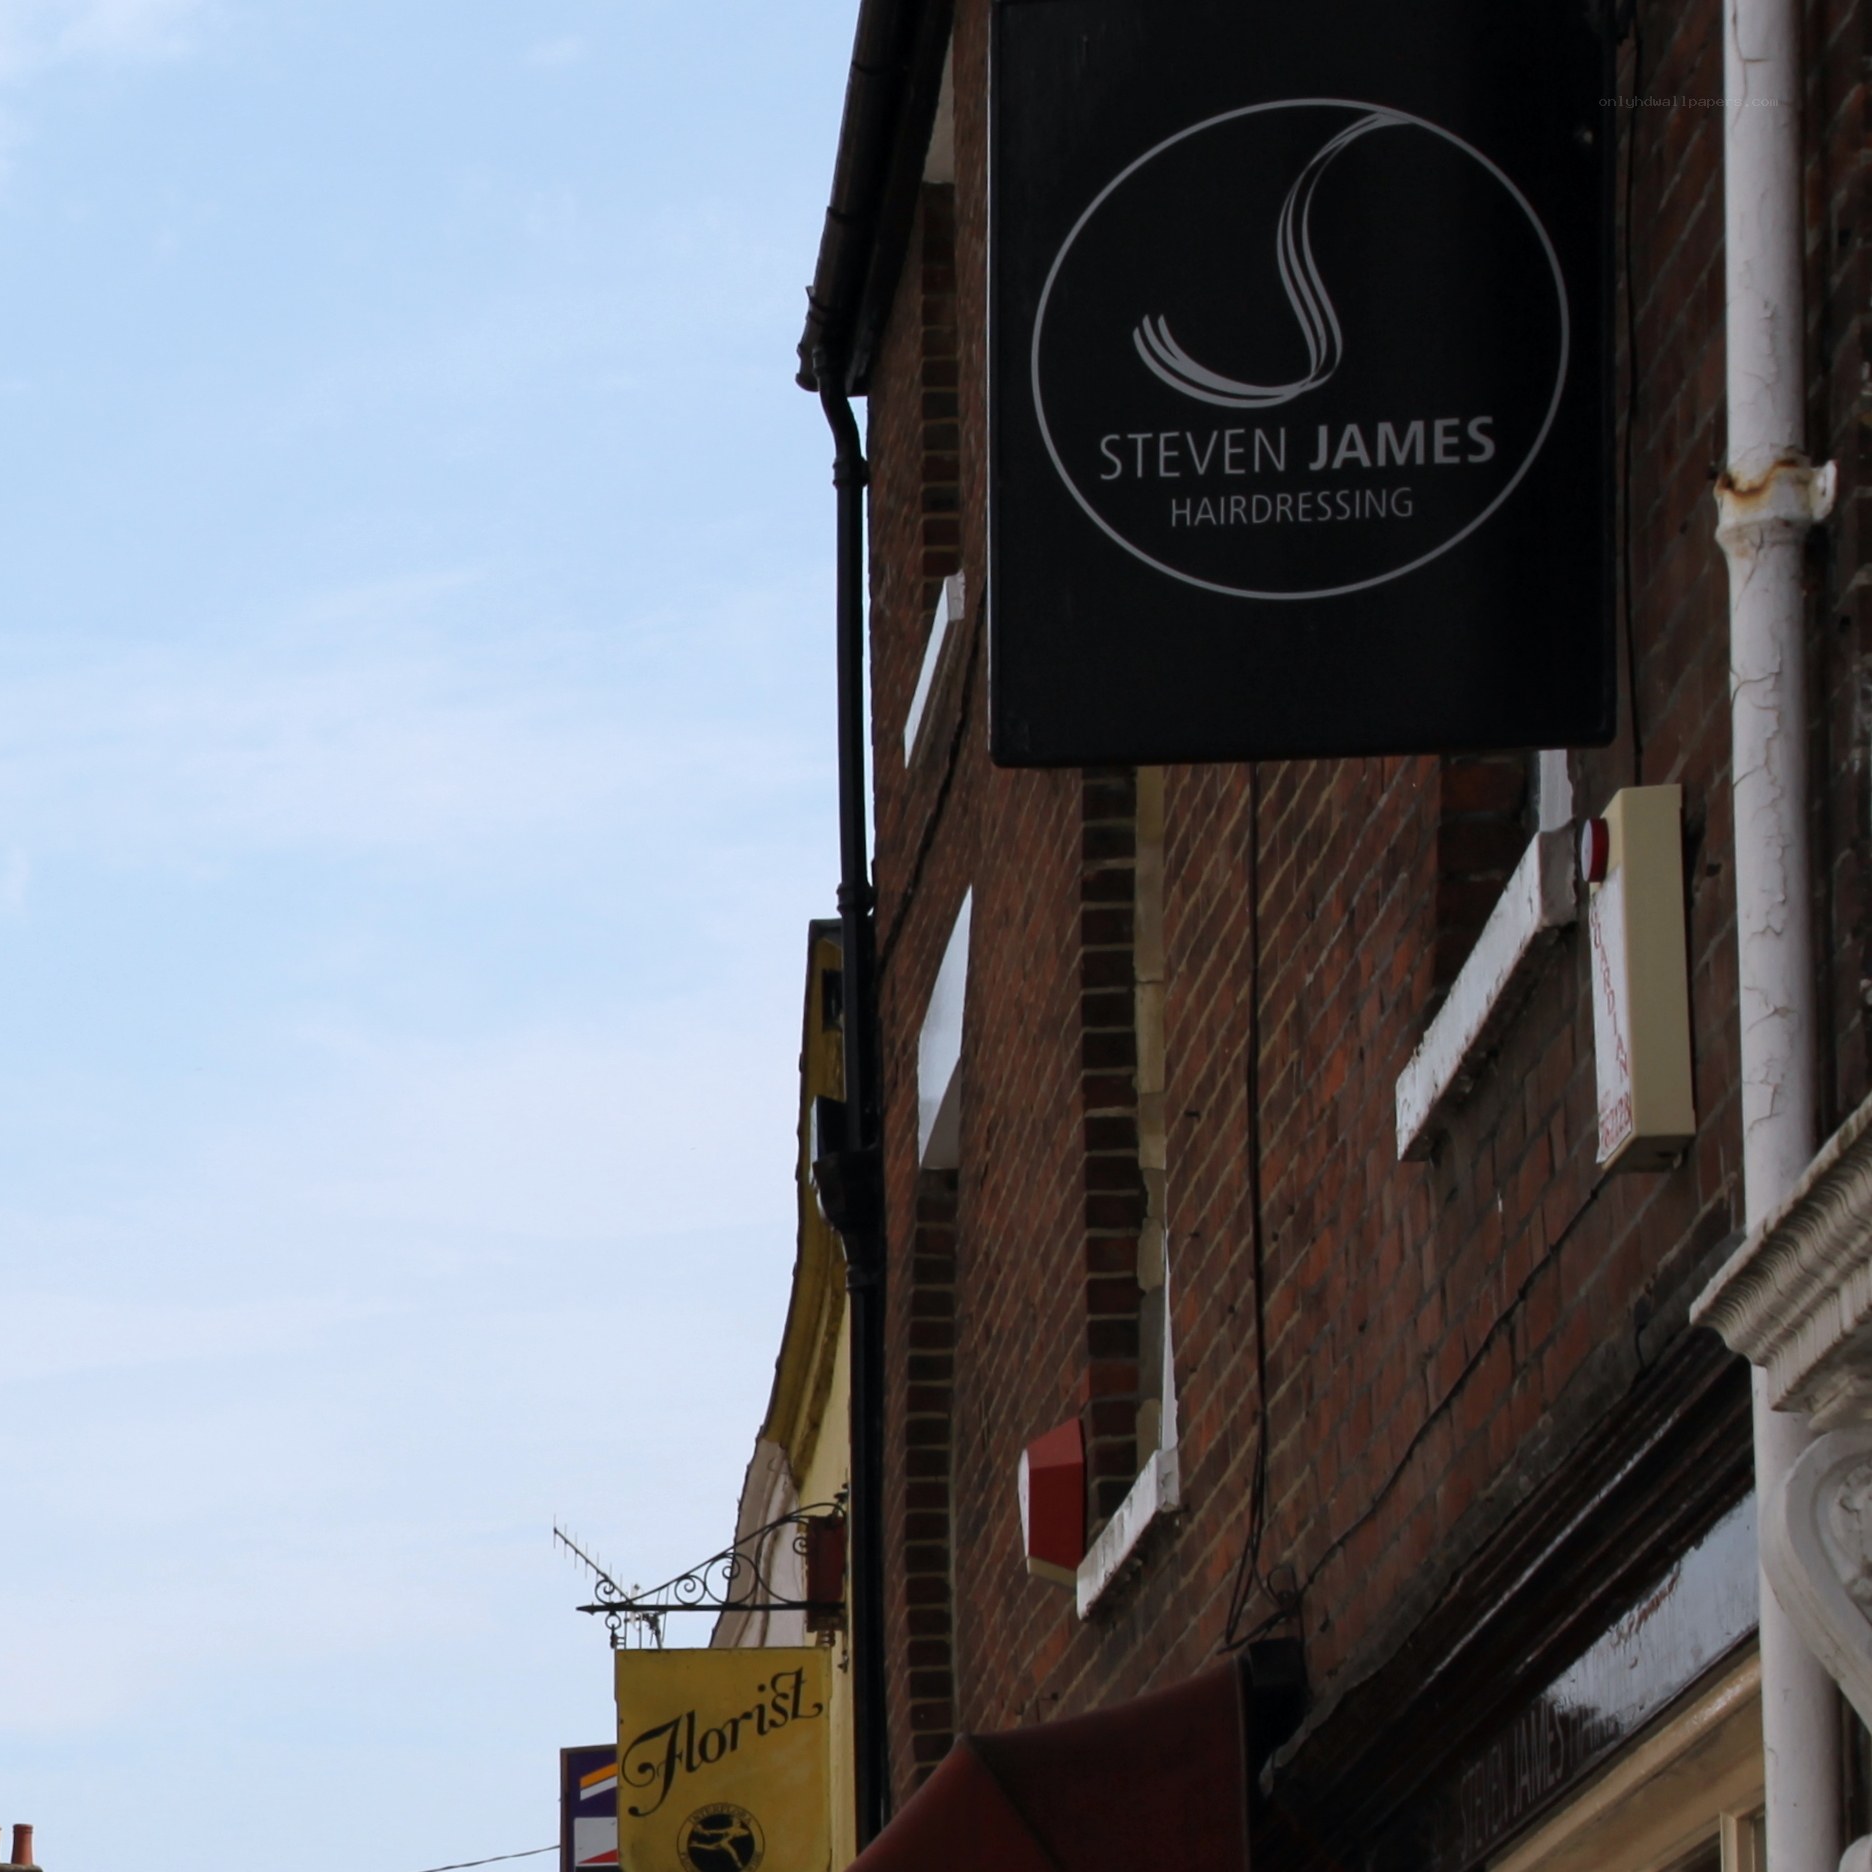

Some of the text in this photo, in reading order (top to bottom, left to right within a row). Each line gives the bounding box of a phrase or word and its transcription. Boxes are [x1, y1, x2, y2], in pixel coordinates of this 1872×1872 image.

[1100, 416, 1496, 480] STEVEN JAMES
[1171, 487, 1414, 527] HAIRDRESSING
[622, 1666, 824, 1817] Florist
[1512, 1699, 1565, 1816] JAMES
